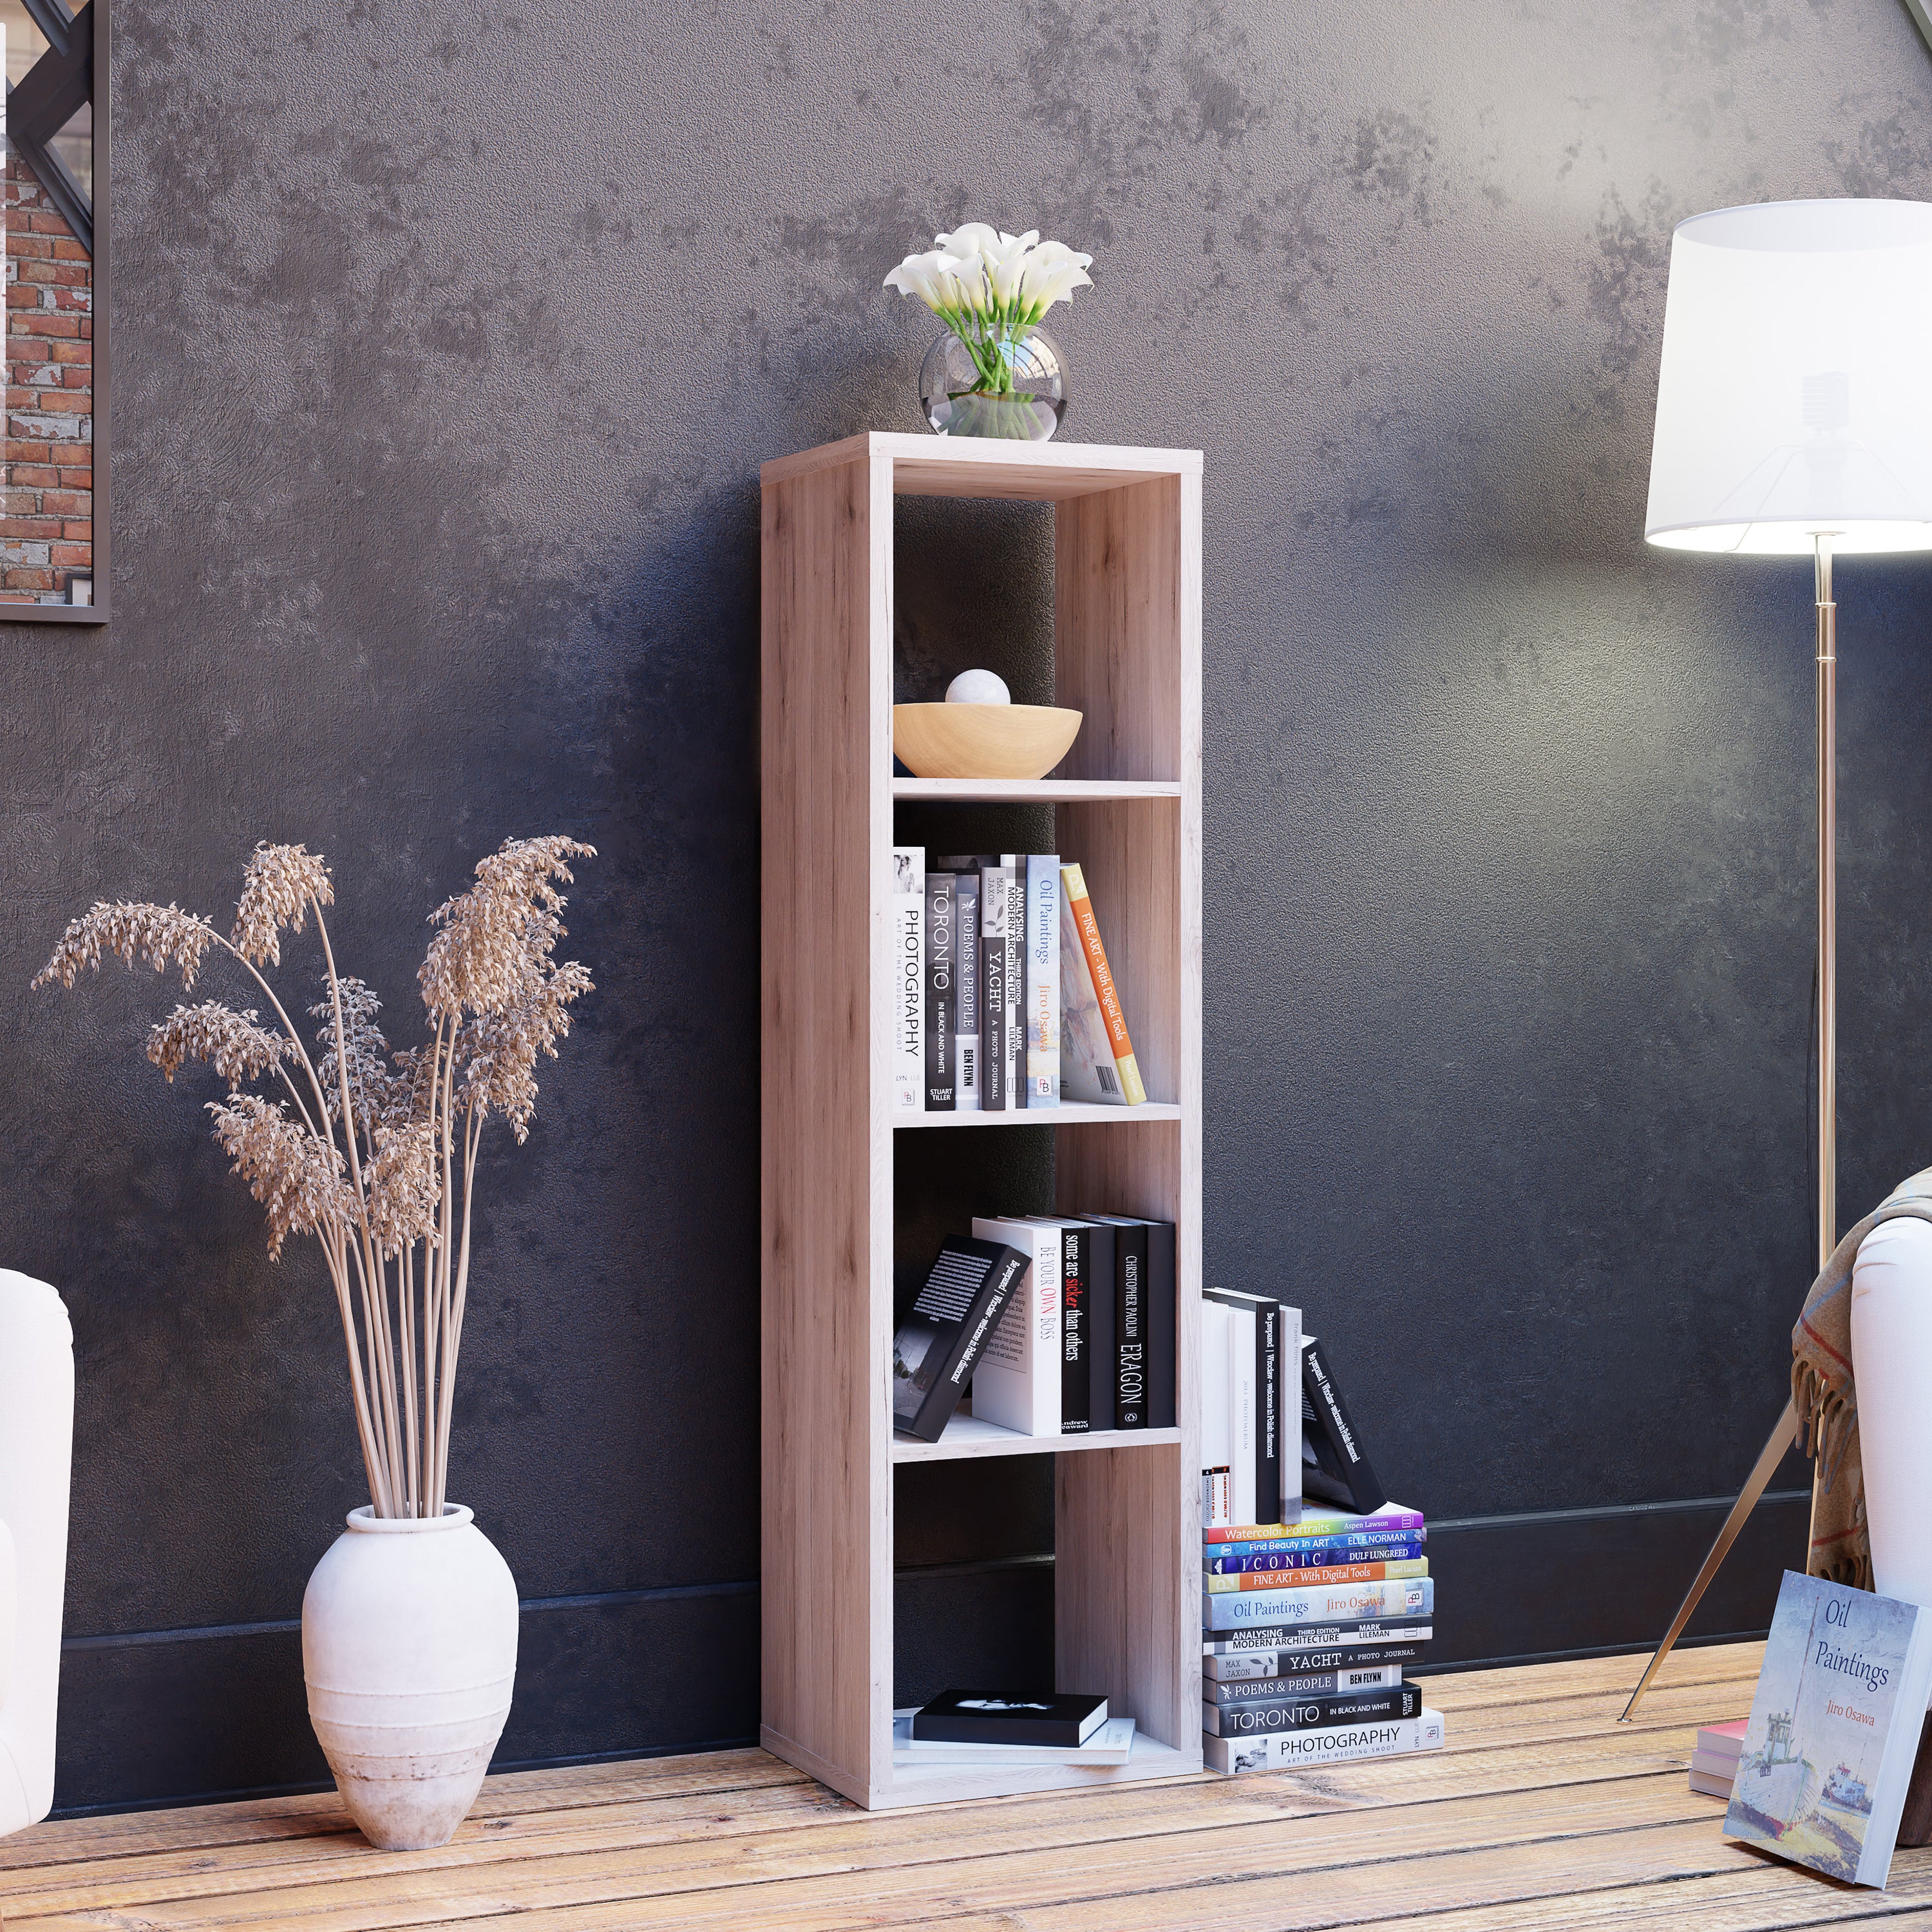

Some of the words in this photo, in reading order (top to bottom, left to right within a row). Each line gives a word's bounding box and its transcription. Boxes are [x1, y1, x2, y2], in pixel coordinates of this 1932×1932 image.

[1040, 880, 1054, 899] Oil
[1016, 886, 1024, 942] ANALYSING
[1082, 912, 1095, 936] FINE
[896, 939, 902, 948] OF
[934, 886, 949, 989] TORONTO
[963, 916, 974, 960] POEMS
[1036, 904, 1052, 964] Paintings
[1088, 938, 1102, 956] ART
[963, 964, 974, 974] &
[1097, 962, 1111, 987] With
[905, 911, 918, 1056] PHOTOGRAPHY
[989, 951, 1001, 1012] YACHT
[963, 978, 974, 1028] PEOPLE
[1037, 985, 1050, 1007] Jiro
[1103, 987, 1120, 1018] Digital
[1040, 1012, 1050, 1052] Osawa
[1112, 1018, 1126, 1041] Tools
[963, 1050, 974, 1063] BEN
[963, 1065, 974, 1086] FLYNN
[1125, 1061, 1133, 1075] Pearl
[1129, 1076, 1139, 1097] Lucian
[1040, 1247, 1056, 1257] BE
[1066, 1235, 1078, 1260] some
[1011, 1260, 1020, 1269] Be
[1041, 1260, 1054, 1286] YOUR
[1066, 1262, 1078, 1276] are
[998, 1265, 1015, 1292] prepared
[1126, 1256, 1137, 1306] CHRISTOPHER
[1040, 1288, 1056, 1314] OWN
[1066, 1278, 1083, 1308] sicker
[1066, 1310, 1083, 1330] than
[1126, 1308, 1137, 1336] PAOLINI
[1267, 1312, 1274, 1321] Be
[1041, 1318, 1056, 1340] BOSS
[1265, 1321, 1274, 1347] prepared
[1066, 1332, 1083, 1361] others
[1308, 1352, 1316, 1361] Be
[1121, 1343, 1142, 1403] ERAGON
[1225, 1526, 1283, 1539] Watercolor
[1286, 1524, 1330, 1535] Portraits
[1348, 1537, 1367, 1545] ELLE
[1368, 1533, 1406, 1543] NORMAN
[1249, 1542, 1266, 1551] Find
[1269, 1540, 1299, 1549] Beauty
[1312, 1539, 1329, 1548] ART
[1349, 1551, 1368, 1561] DULF
[1370, 1549, 1408, 1558] LUNGREED
[1242, 1553, 1320, 1571] ICONIC
[1253, 1575, 1274, 1586] FINE
[1275, 1573, 1294, 1584] ART
[1300, 1569, 1320, 1581] With
[1322, 1567, 1349, 1582] Digital
[1350, 1566, 1370, 1578] Tools
[1234, 1601, 1251, 1618] Oil
[1256, 1601, 1309, 1618] Paintings
[1326, 1598, 1346, 1612] Jiro
[1349, 1596, 1385, 1607] Osawa
[1826, 1600, 1852, 1627] Oil
[1233, 1629, 1283, 1640] ANALYSING
[1233, 1638, 1273, 1649] MODERN
[1275, 1634, 1340, 1645] ARCHITECTURE
[1290, 1653, 1341, 1670] YACHT
[1384, 1649, 1415, 1658] JOURNAL
[1815, 1641, 1889, 1692] Paintings
[1226, 1669, 1251, 1678] JAXON
[1350, 1673, 1362, 1685] BEN
[1363, 1672, 1381, 1683] FLYNN
[1235, 1682, 1274, 1696] POEMS
[1277, 1681, 1285, 1692] &
[1289, 1676, 1332, 1690] PEOPLE
[1231, 1706, 1320, 1730] TORONTO
[1826, 1700, 1843, 1716] Jiro
[1845, 1706, 1875, 1726] Osawa
[1281, 1727, 1401, 1756] PHOTOGRAPHY
[1334, 1748, 1367, 1757] WEDDING
